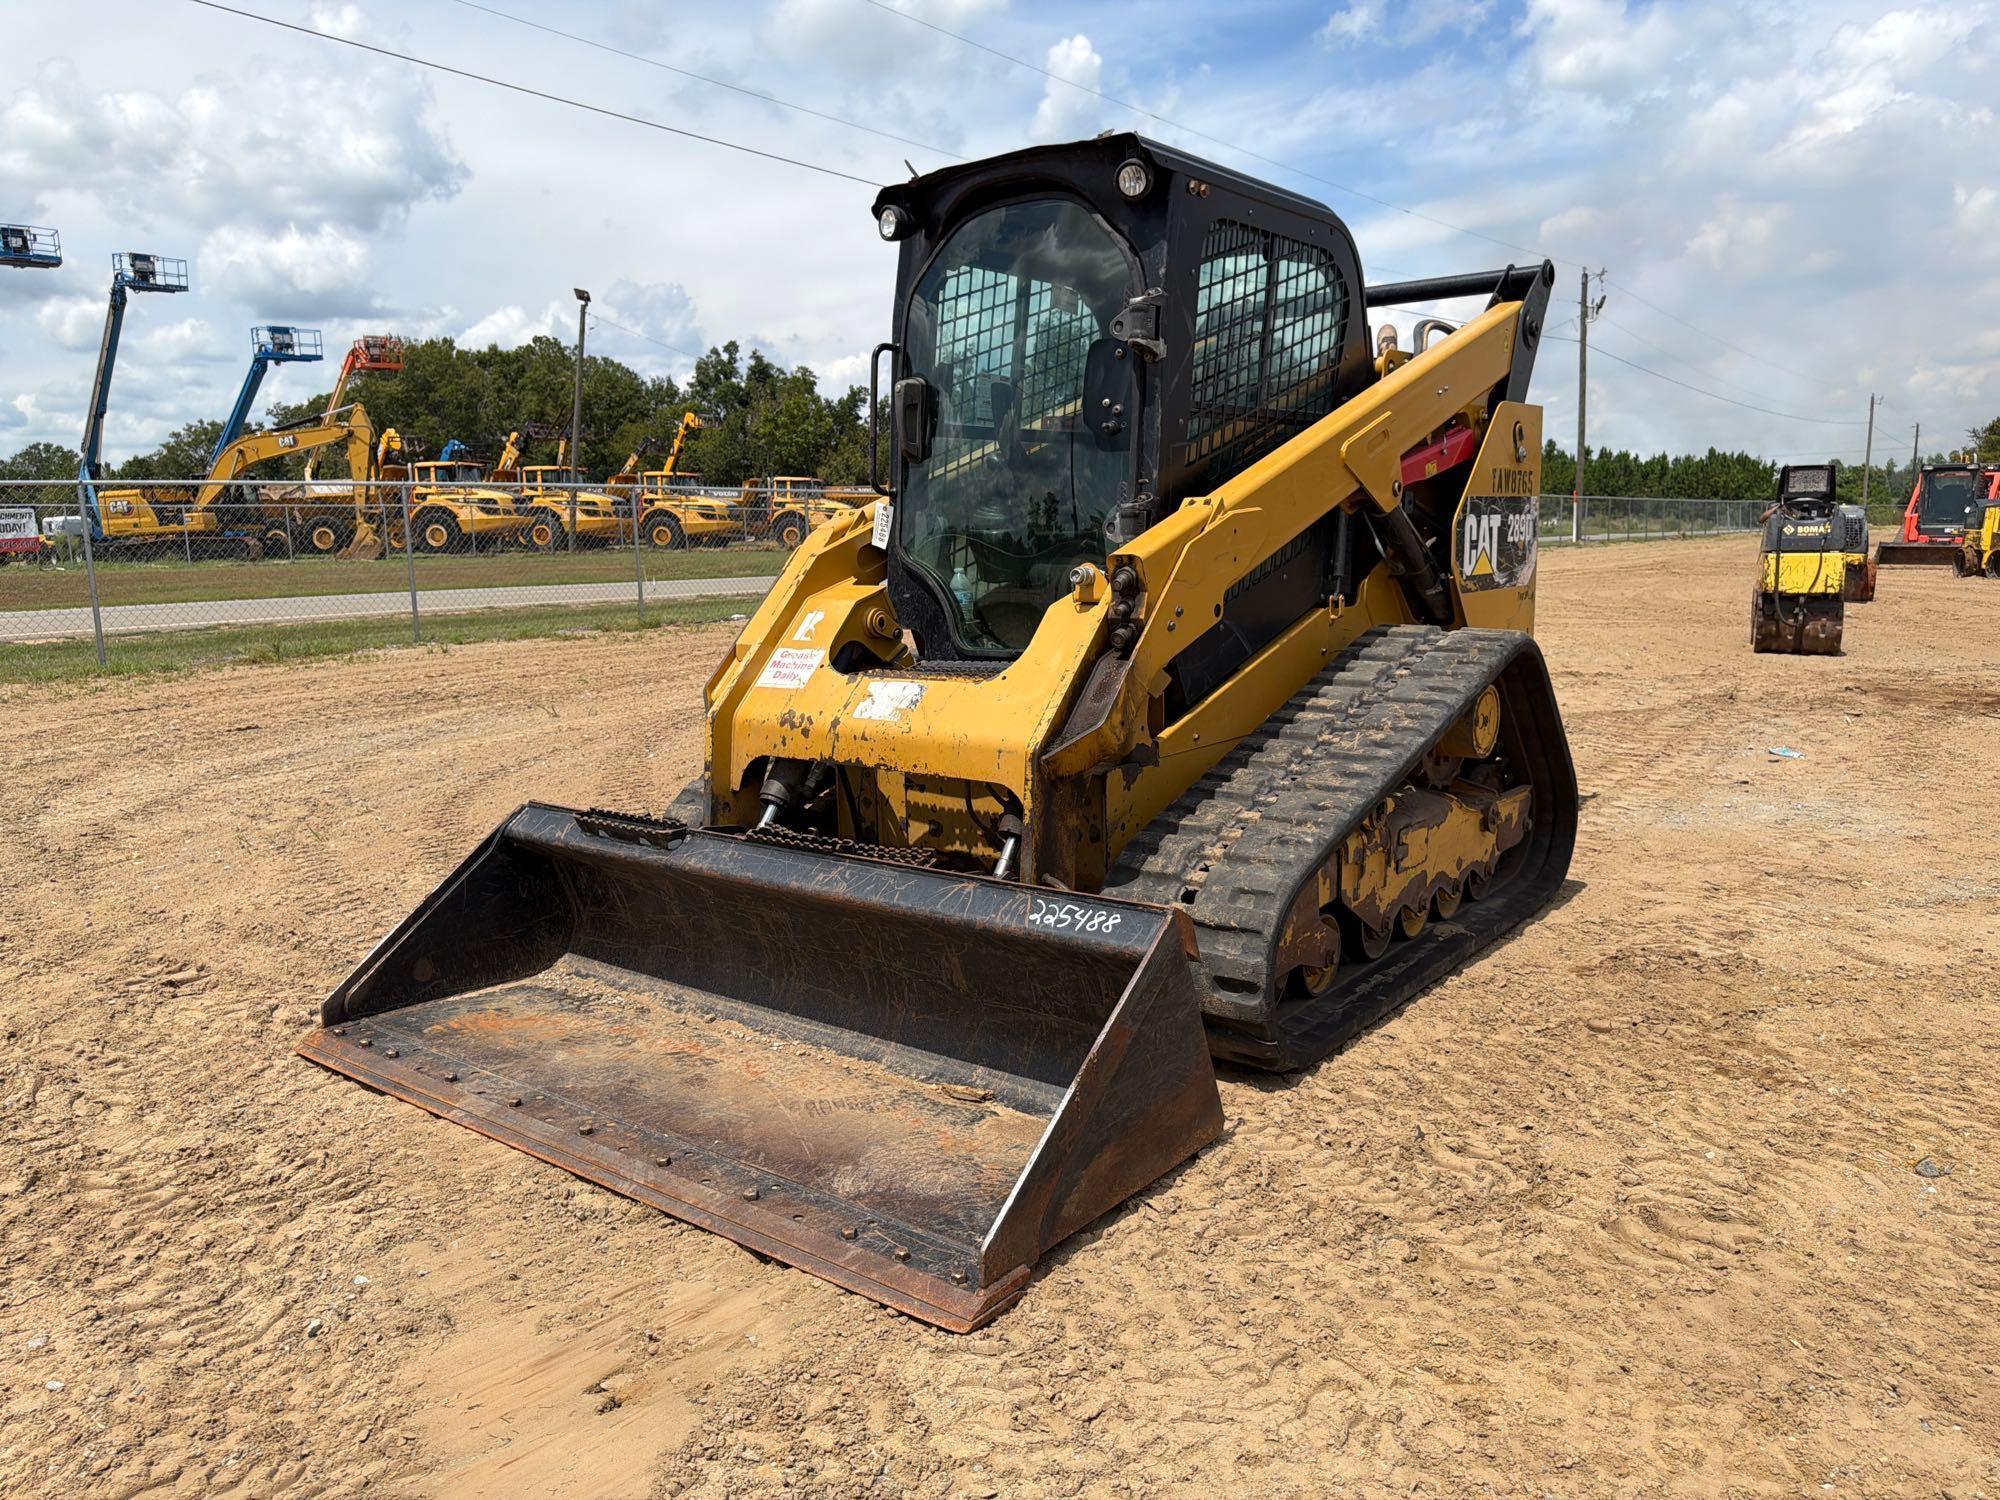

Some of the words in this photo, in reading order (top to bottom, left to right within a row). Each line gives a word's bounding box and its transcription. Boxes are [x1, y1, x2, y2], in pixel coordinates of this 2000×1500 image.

[278, 435, 295, 448] CAT
[109, 500, 129, 513] CAT
[878, 512, 890, 543] 225488
[1463, 513, 1501, 577] CAT
[770, 660, 814, 670] Machine
[773, 670, 800, 682] Daily
[1029, 899, 1121, 933] 225488
